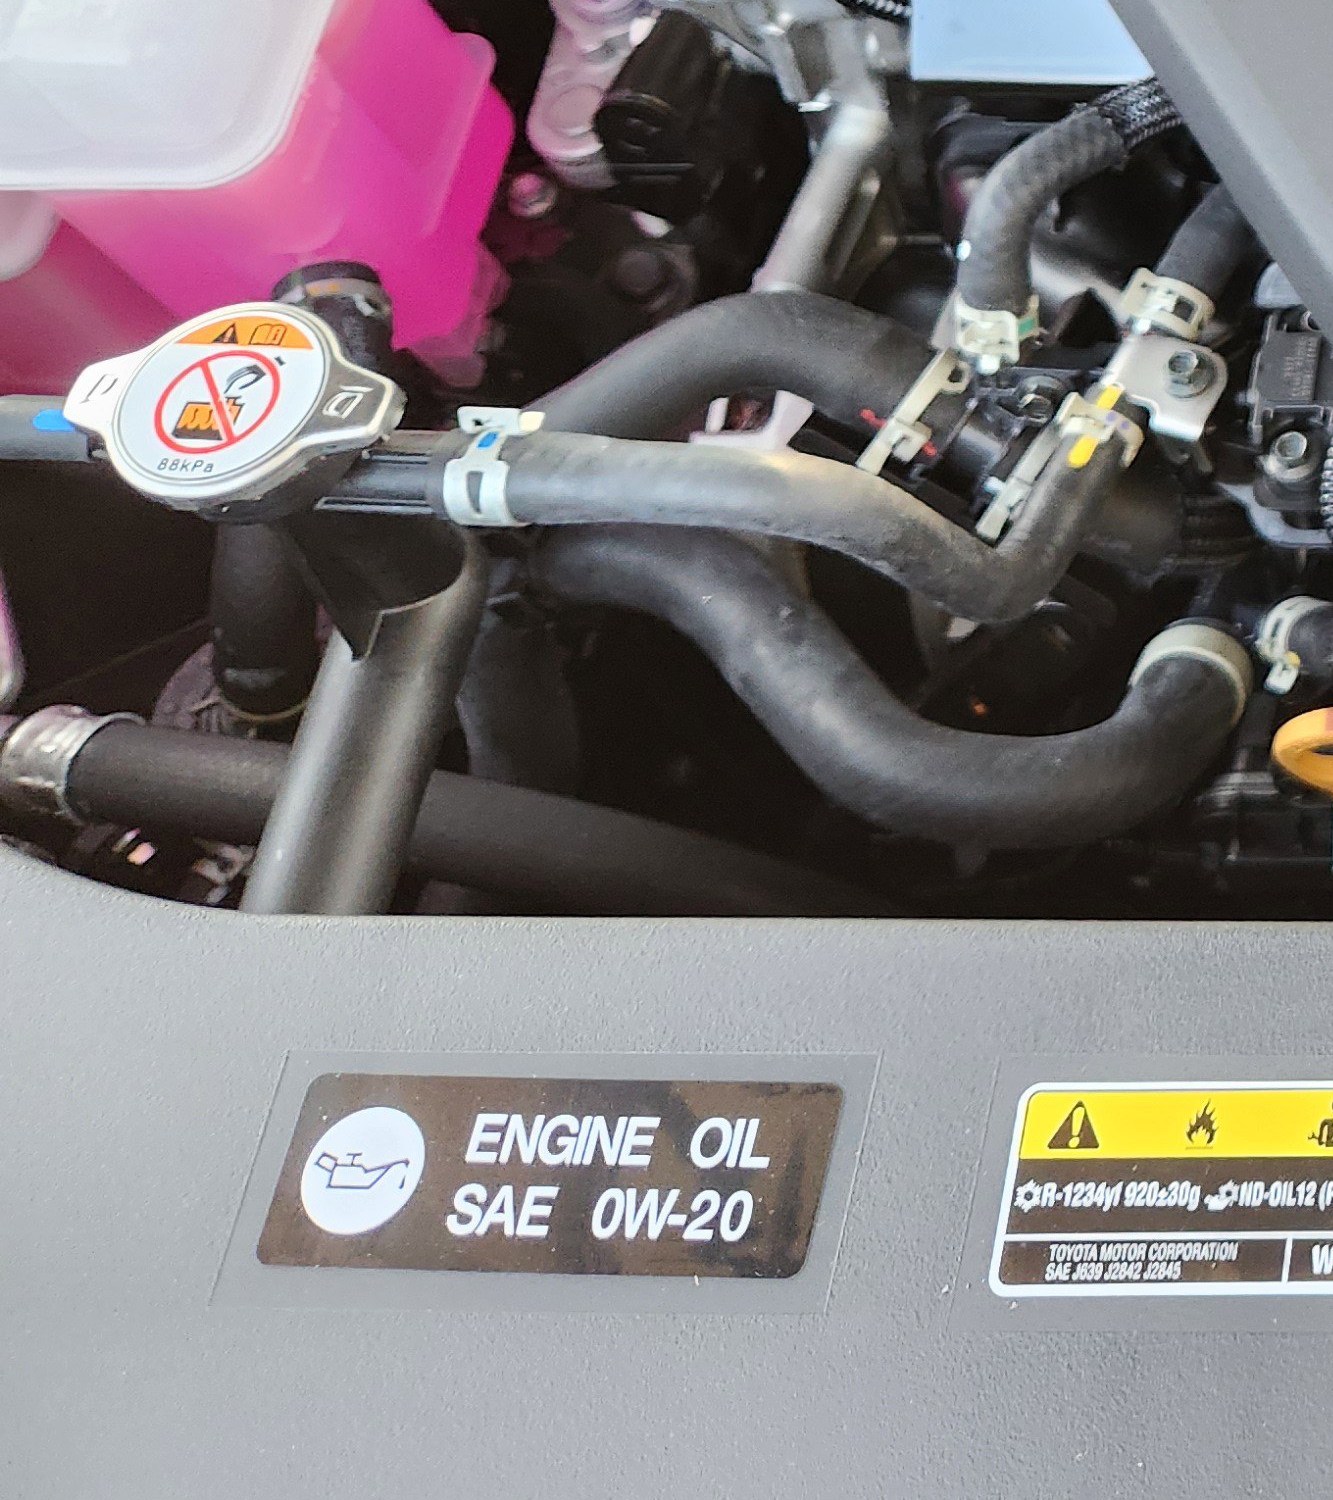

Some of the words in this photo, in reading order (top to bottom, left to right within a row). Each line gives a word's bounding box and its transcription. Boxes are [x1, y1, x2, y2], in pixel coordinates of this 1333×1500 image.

[157, 458, 214, 473] 88kPa
[464, 1113, 662, 1167] ENGINE
[689, 1117, 771, 1169] OIL
[446, 1184, 559, 1239] SAE
[590, 1189, 755, 1242] 0W-20
[1049, 1243, 1099, 1262] TOYOTA
[1099, 1243, 1147, 1262] MOTOR
[1148, 1242, 1238, 1262] CORPORATION
[1045, 1262, 1072, 1281] SAE
[1072, 1263, 1103, 1280] J639
[1103, 1262, 1143, 1280] J2842
[1143, 1262, 1182, 1280] J2845
